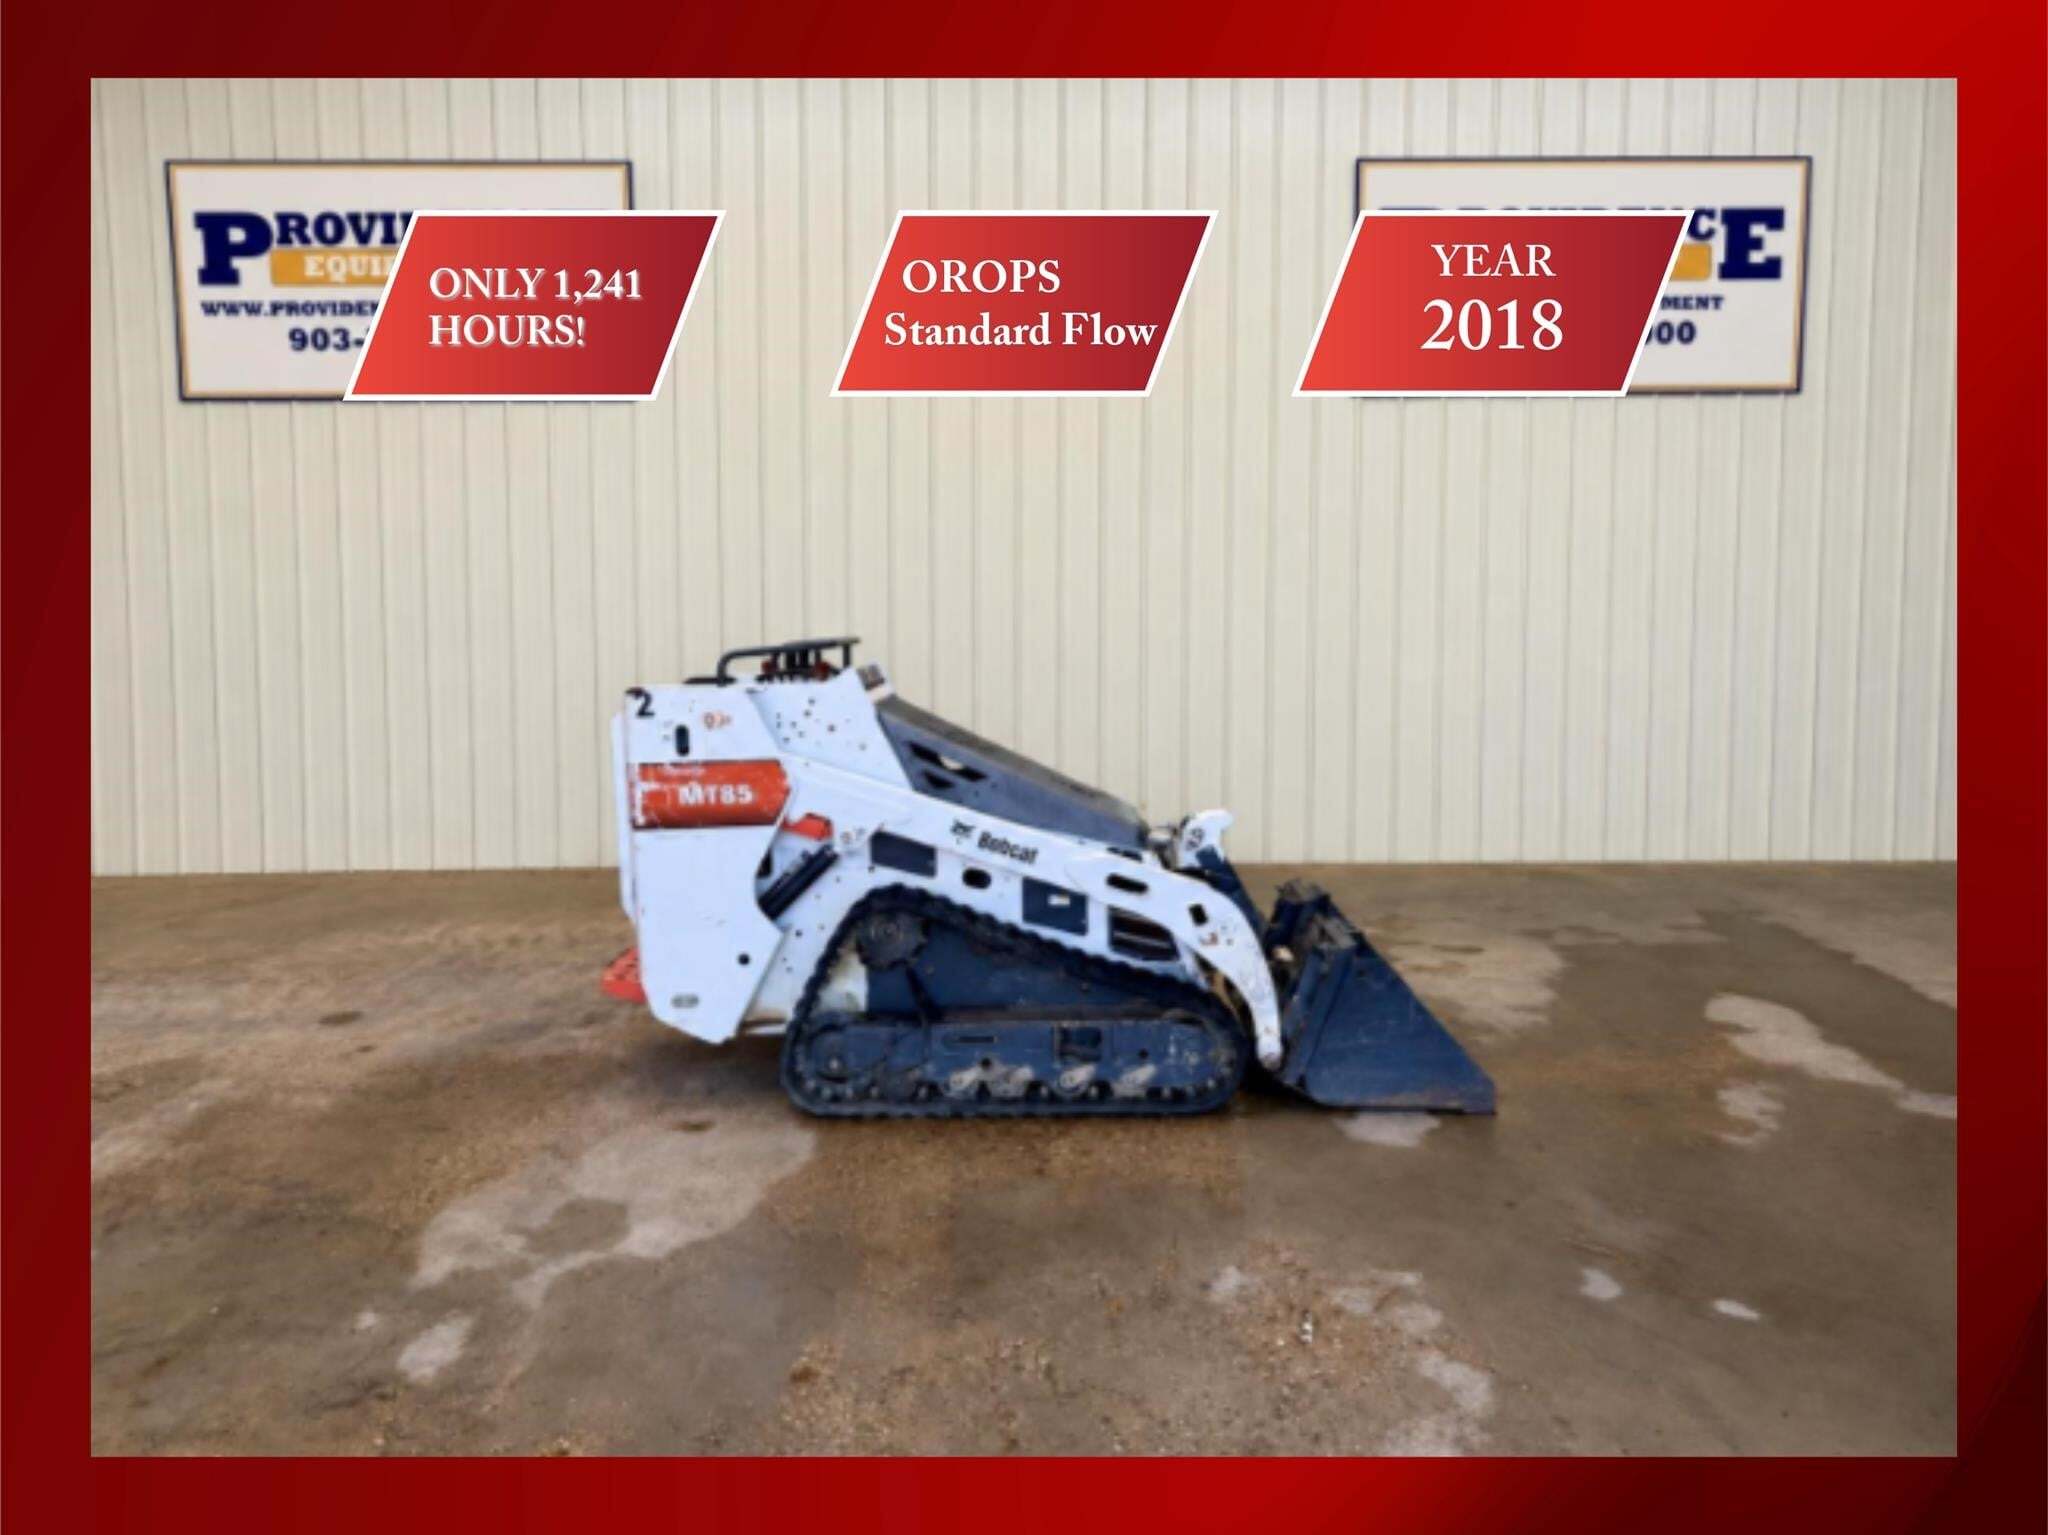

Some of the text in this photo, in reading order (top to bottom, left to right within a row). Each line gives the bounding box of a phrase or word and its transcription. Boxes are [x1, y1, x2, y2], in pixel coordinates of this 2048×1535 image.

[193, 211, 413, 286] PROVI
[303, 254, 398, 283] EQUI
[288, 326, 371, 352] 903-
[635, 687, 656, 718] 2
[679, 781, 754, 806] MT85
[977, 830, 1040, 866] Bobcat
